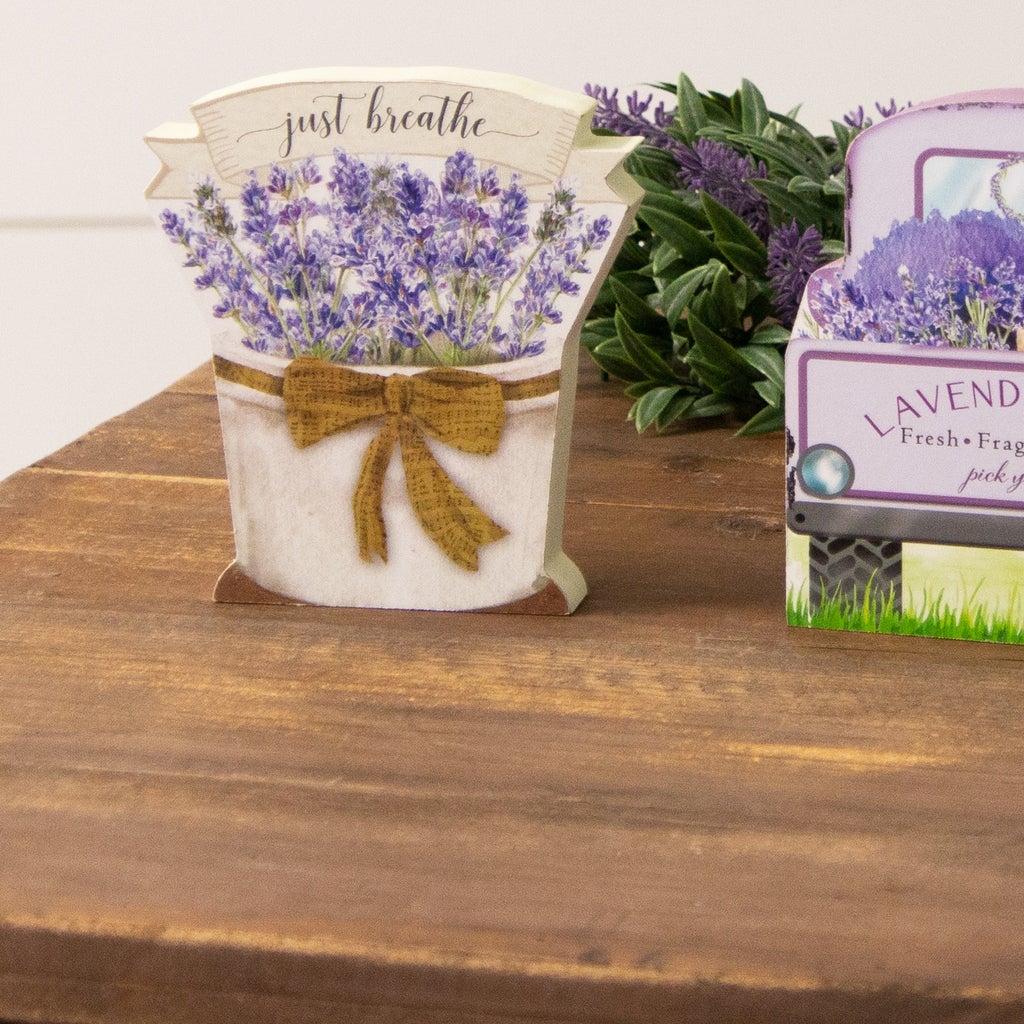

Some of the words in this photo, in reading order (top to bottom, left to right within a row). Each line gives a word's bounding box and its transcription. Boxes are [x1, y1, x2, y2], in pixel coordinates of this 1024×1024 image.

[237, 92, 367, 158] just
[366, 85, 539, 139] breathe
[899, 427, 960, 448] Fresh
[957, 460, 1009, 494] pick
